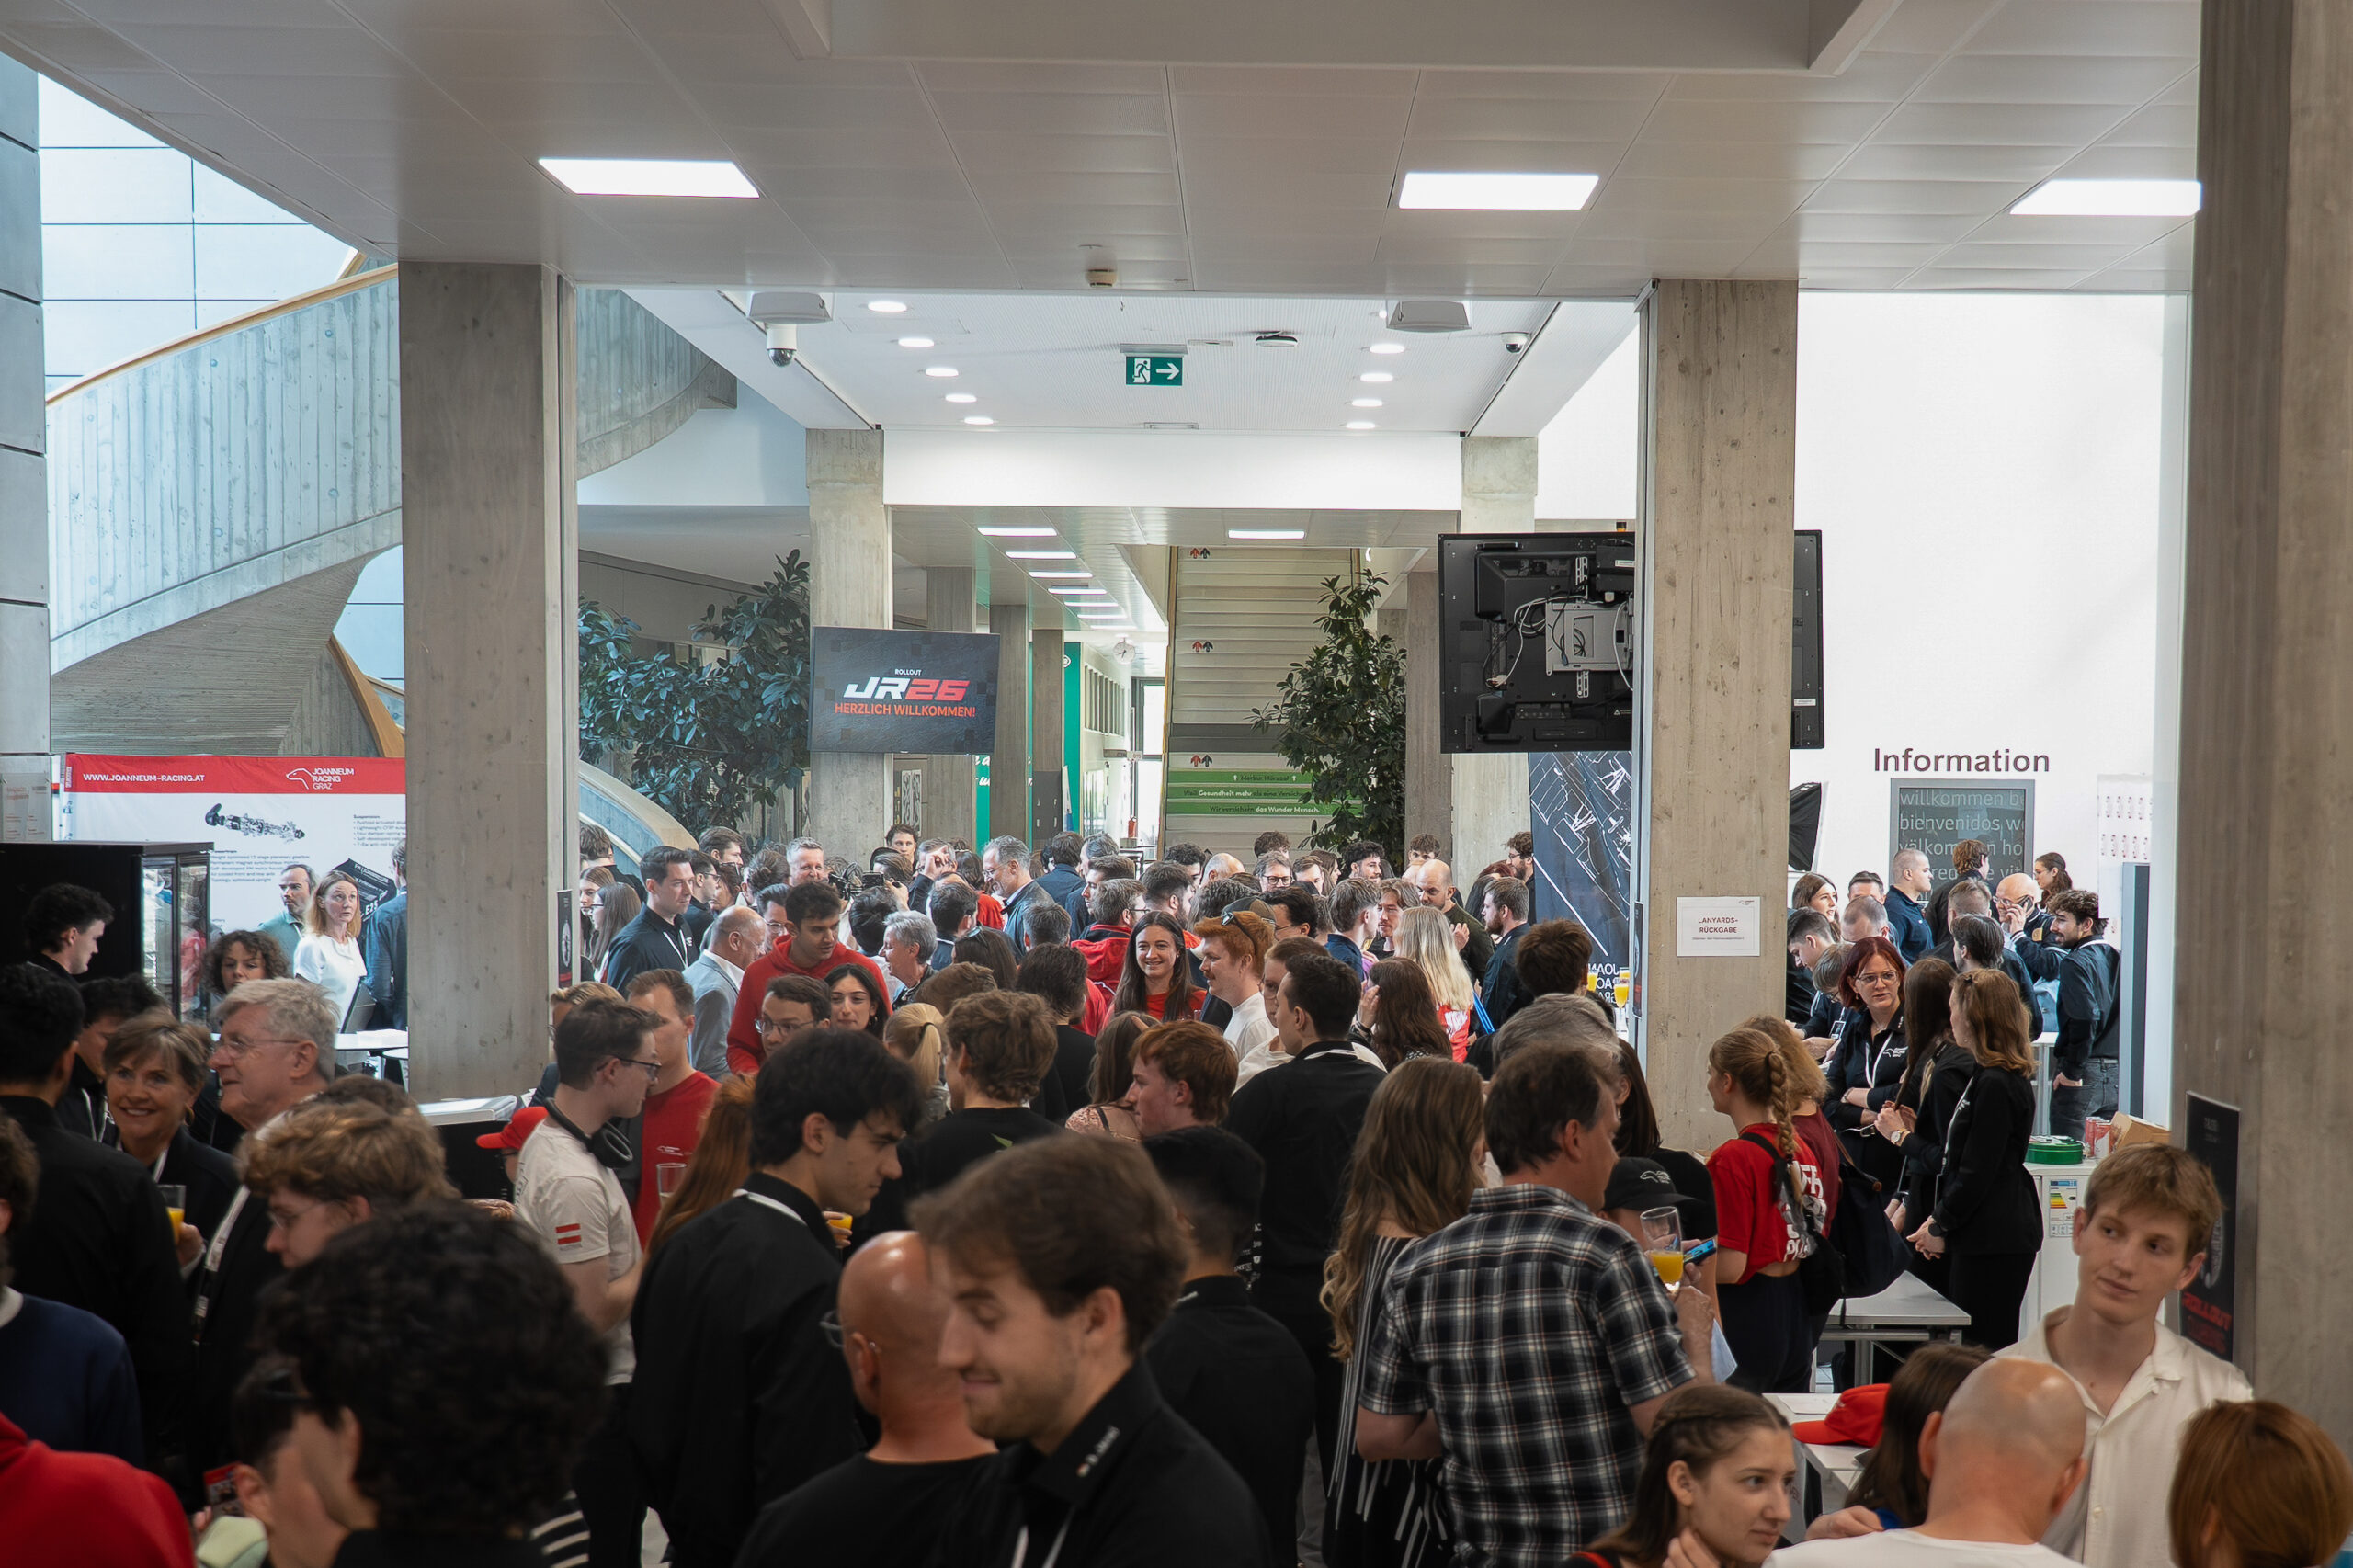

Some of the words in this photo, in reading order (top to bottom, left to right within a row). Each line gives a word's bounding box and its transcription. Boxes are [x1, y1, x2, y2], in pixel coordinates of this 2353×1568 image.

[843, 676, 971, 701] JR26
[835, 702, 892, 716] HERZLICH
[894, 704, 976, 717] WILLKOMMEN!
[1874, 747, 2050, 773] Information
[83, 774, 205, 782] WWW.JOANNEUM-RACING.AT
[313, 767, 355, 776] JOANNEUM
[313, 775, 342, 783] RACING
[1900, 790, 2003, 806] willkommen
[1900, 813, 2000, 831] bienvenidos
